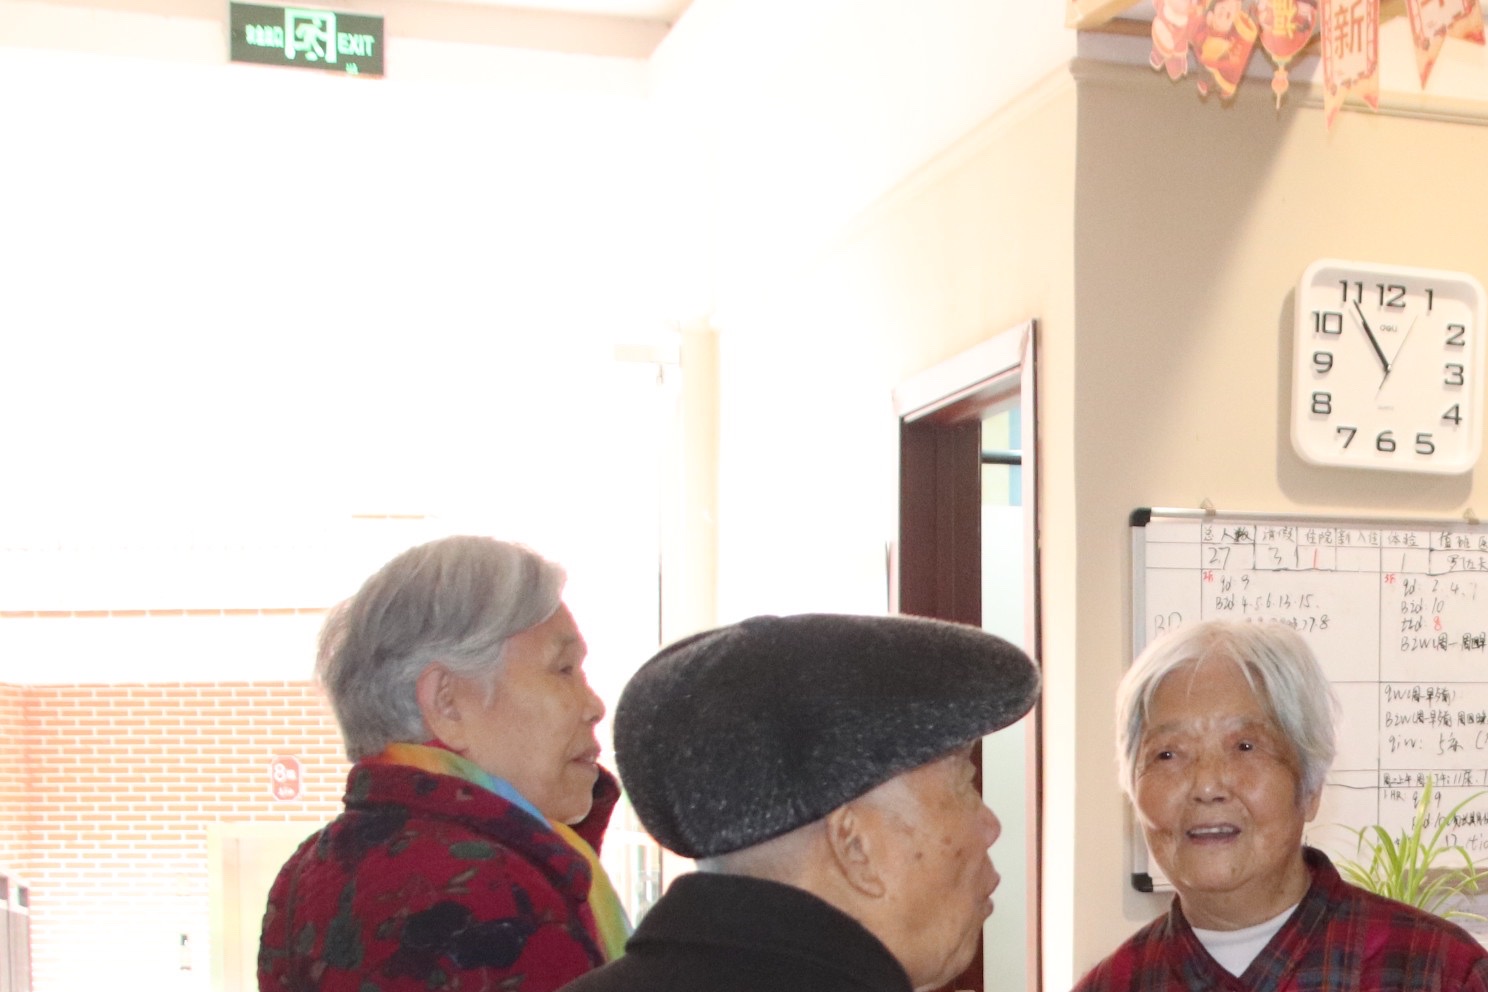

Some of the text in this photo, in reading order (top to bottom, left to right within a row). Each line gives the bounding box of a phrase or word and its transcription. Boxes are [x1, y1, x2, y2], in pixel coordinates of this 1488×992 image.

[1335, 2, 1363, 58] 新
[337, 32, 375, 57] EXIT
[1339, 280, 1363, 304] 11
[1376, 284, 1406, 308] 12
[1425, 289, 1434, 311] 1
[1312, 310, 1343, 335] 10
[1445, 323, 1466, 347] 2
[1313, 351, 1333, 374] 9
[1444, 363, 1464, 386] 3
[1311, 391, 1332, 415] 8
[1441, 403, 1463, 425] 4
[1336, 426, 1358, 449] 7
[1376, 430, 1396, 453] 6
[1415, 432, 1435, 455] 5
